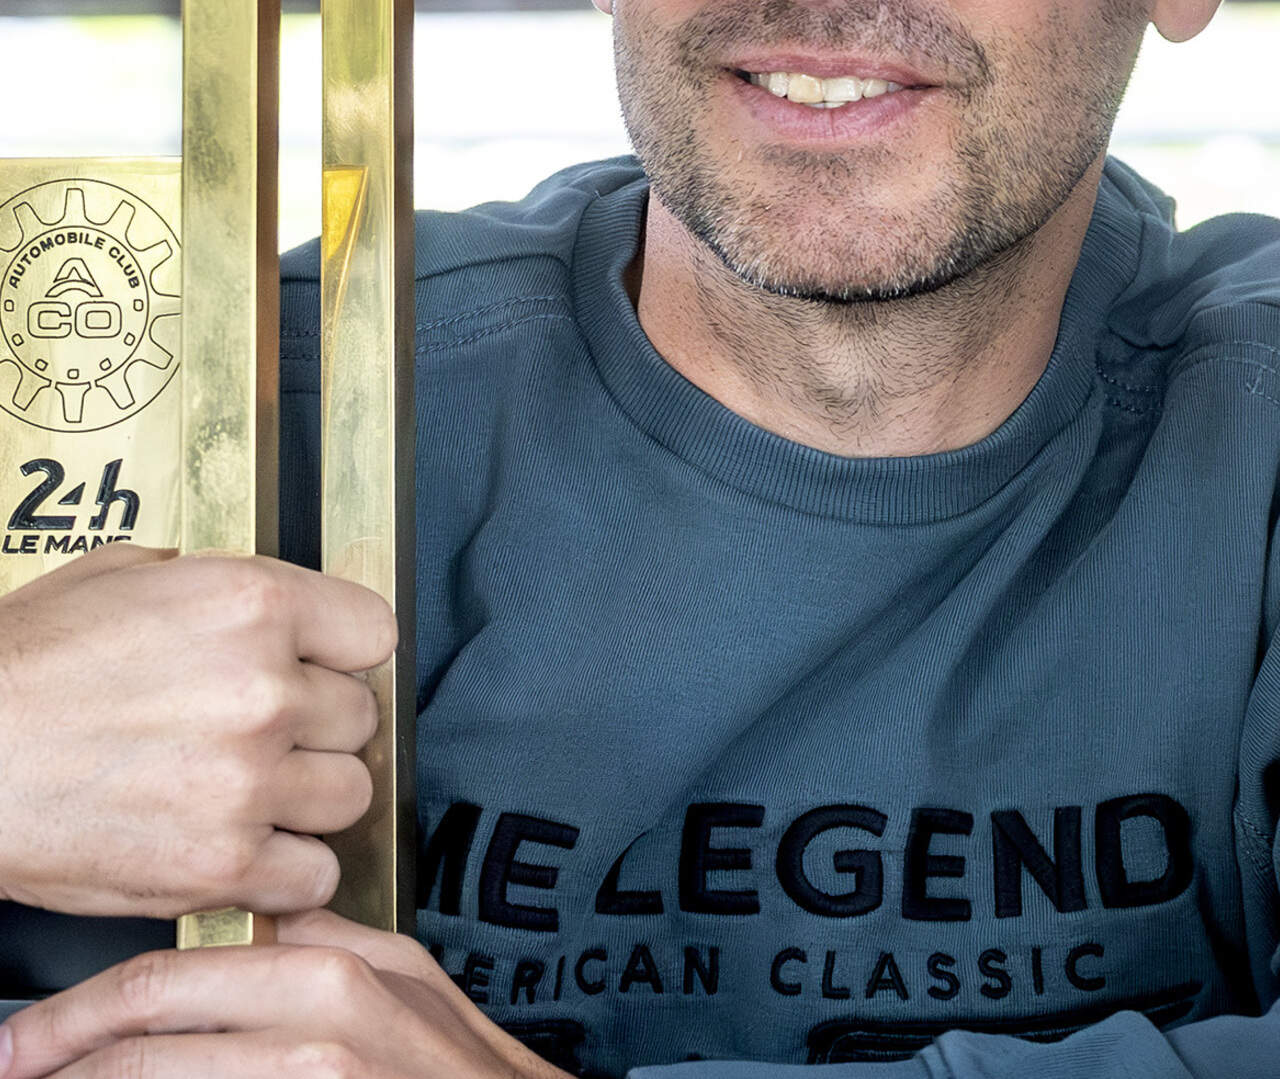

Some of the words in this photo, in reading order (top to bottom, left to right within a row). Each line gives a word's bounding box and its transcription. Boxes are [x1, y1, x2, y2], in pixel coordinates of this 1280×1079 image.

[8, 231, 107, 289] AUTOMOBILE
[108, 246, 141, 289] CLUB
[6, 457, 141, 531] 24h
[1, 534, 41, 554] LE
[43, 534, 132, 555] MAN
[594, 792, 1198, 920] LEGEND
[429, 942, 721, 1006] ERICAN
[769, 941, 1109, 1003] CLASSIC
